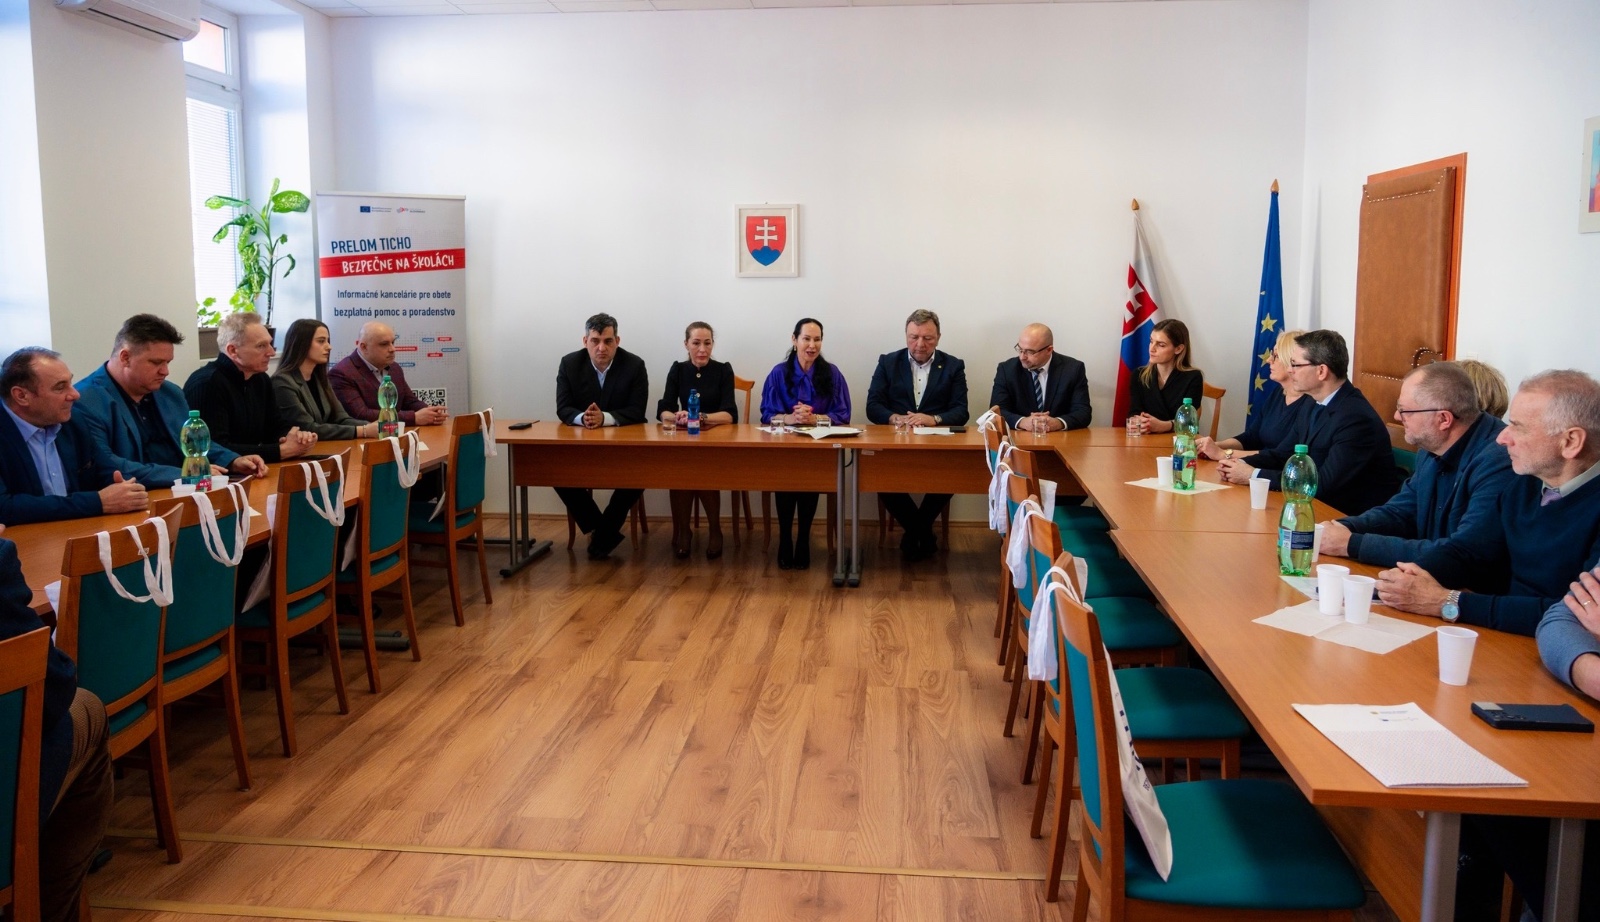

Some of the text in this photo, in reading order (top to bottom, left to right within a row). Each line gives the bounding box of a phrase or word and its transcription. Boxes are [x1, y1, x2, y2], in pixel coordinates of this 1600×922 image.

[331, 236, 412, 254] PRELOM TICHO
[342, 252, 455, 274] BEZPEČNE NA ŠKOLÁCH
[337, 289, 451, 301] Informačné kancelárie pre obete
[334, 307, 372, 318] bezplatná
[374, 309, 400, 318] pomoc
[409, 307, 456, 318] poradenstvo
